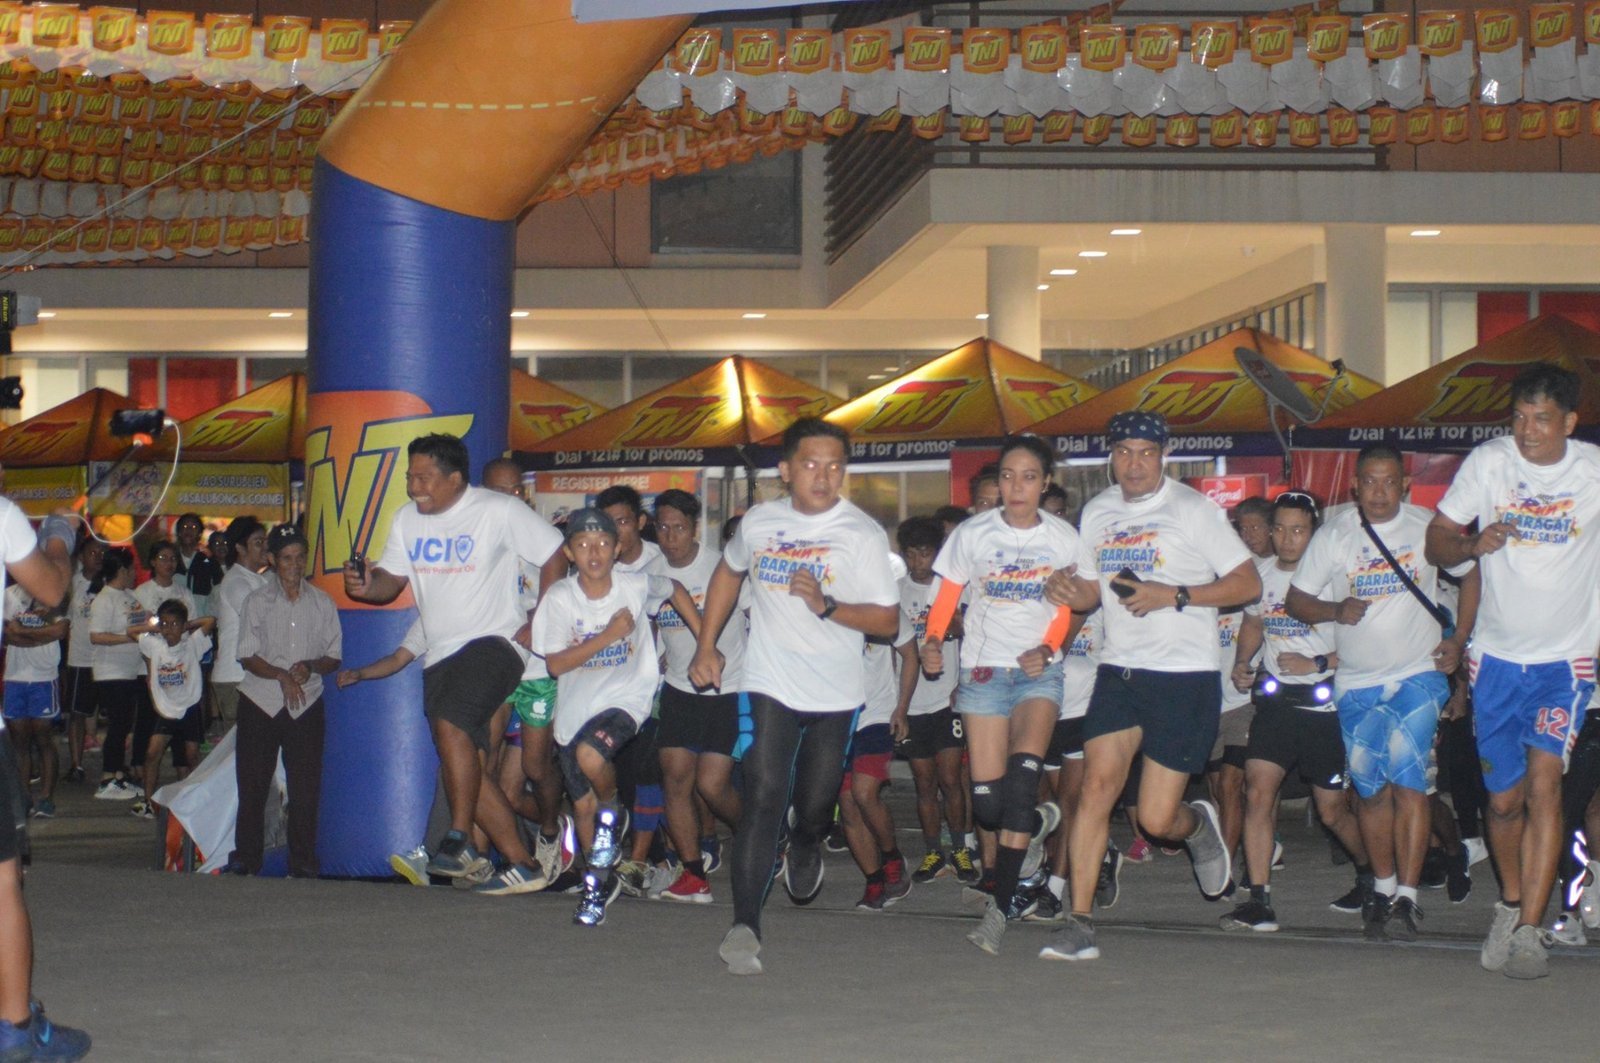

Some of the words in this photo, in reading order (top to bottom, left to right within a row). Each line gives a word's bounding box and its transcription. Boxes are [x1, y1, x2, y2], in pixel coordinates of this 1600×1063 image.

[40, 16, 73, 35] TNT
[98, 16, 130, 42] TNT
[153, 21, 188, 43] TNT
[213, 25, 245, 49] TNT
[1371, 23, 1404, 49] TNT
[1424, 23, 1456, 47] TNT
[1483, 18, 1511, 45] TNT
[1536, 13, 1568, 38] TNT
[271, 26, 305, 50] TNT
[328, 31, 362, 52] TNT
[1087, 35, 1120, 58] TNT
[1140, 36, 1171, 57] TNT
[1199, 33, 1229, 57] TNT
[1256, 30, 1289, 52] TNT
[1313, 26, 1345, 49] TNT
[740, 41, 773, 64] TNT
[792, 39, 824, 63] TNT
[851, 39, 883, 64] TNT
[911, 40, 943, 62] TNT
[970, 40, 1002, 64] TNT
[1028, 38, 1060, 62] TNT
[858, 380, 982, 431] TNT
[616, 402, 730, 441] TNT
[1349, 425, 1384, 441] Dial
[1440, 425, 1467, 439] for
[871, 441, 892, 456] for
[896, 441, 956, 458] promos
[1057, 437, 1087, 452] Dial
[1169, 436, 1233, 453] promos
[554, 450, 582, 465] Dial
[624, 448, 646, 461] for
[649, 449, 703, 465] promos
[552, 477, 609, 490] REGISTER
[408, 537, 452, 562] JCI
[1552, 534, 1568, 544] SM
[1101, 549, 1155, 562] BARAGAT
[758, 571, 790, 585] BAGAT
[760, 556, 824, 579] BARAGAT
[1142, 563, 1153, 573] SM
[1357, 586, 1383, 597] BAGAT
[1386, 586, 1397, 594] SA
[605, 659, 614, 667] SA
[615, 657, 628, 666] SM
[952, 719, 963, 738] 8
[1534, 707, 1569, 740] 42
